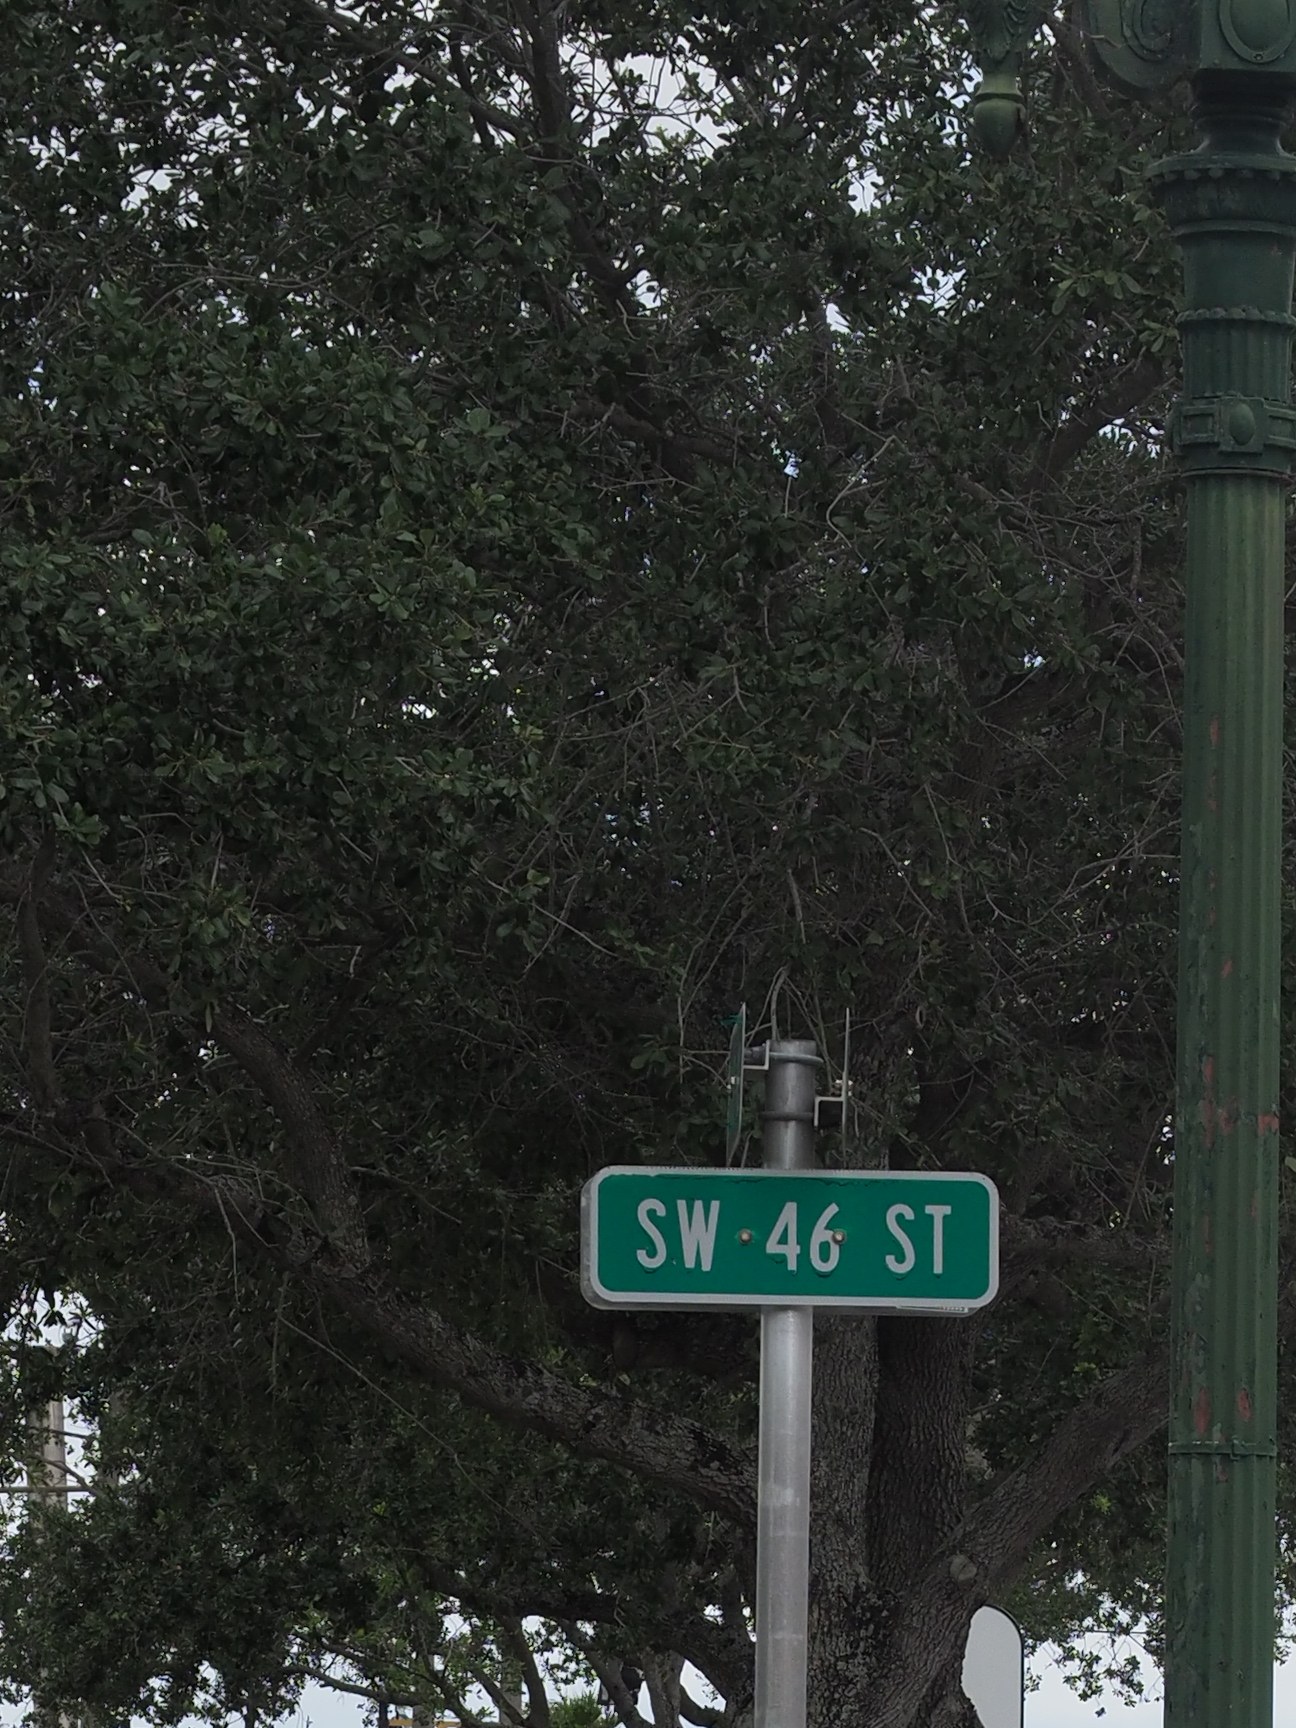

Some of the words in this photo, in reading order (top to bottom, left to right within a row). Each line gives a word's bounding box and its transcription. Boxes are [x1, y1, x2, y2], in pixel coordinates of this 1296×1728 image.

[636, 1198, 720, 1272] SW
[766, 1201, 842, 1273] 46
[885, 1203, 952, 1274] ST
